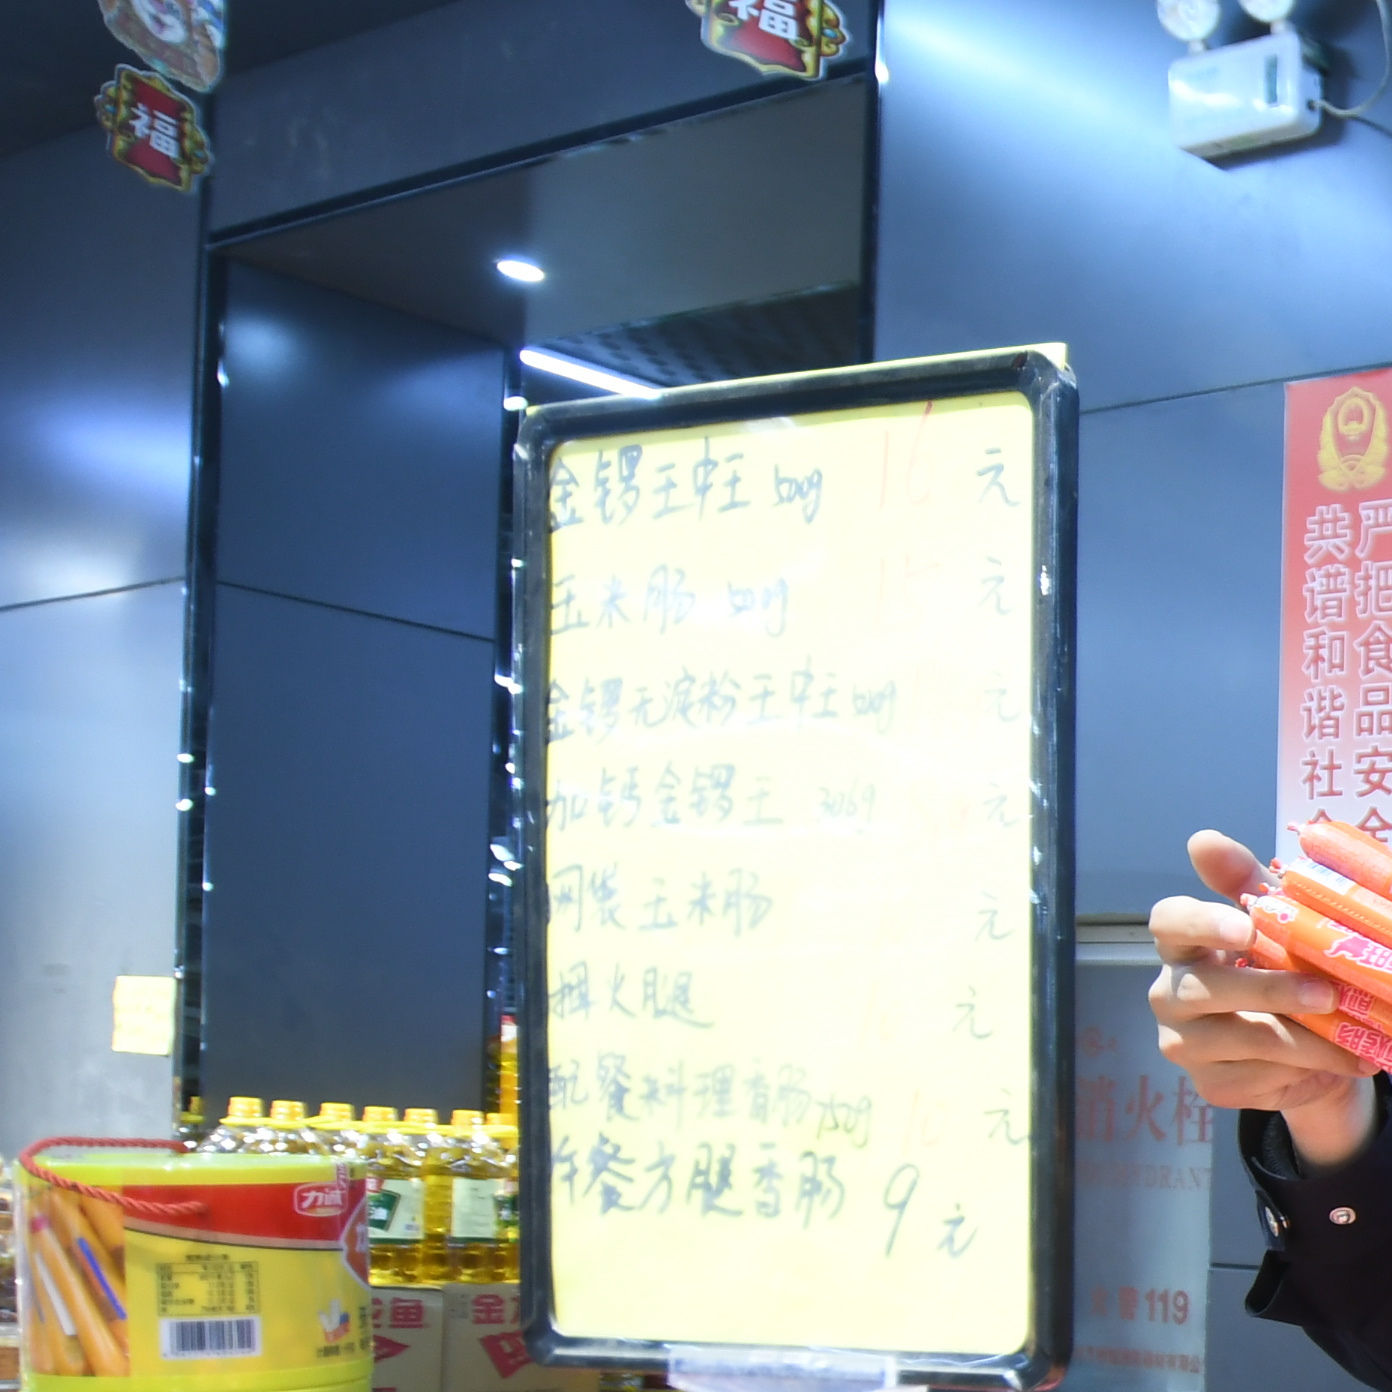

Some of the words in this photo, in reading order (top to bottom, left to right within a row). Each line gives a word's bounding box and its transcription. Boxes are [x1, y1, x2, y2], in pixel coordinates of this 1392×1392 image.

[129, 102, 180, 159] 福
[977, 448, 1021, 508] 元
[981, 556, 1014, 616] 元
[974, 890, 1015, 941] 元
[951, 986, 993, 1040] 元
[936, 1204, 979, 1258] 元
[1145, 1288, 1189, 1325] 119
